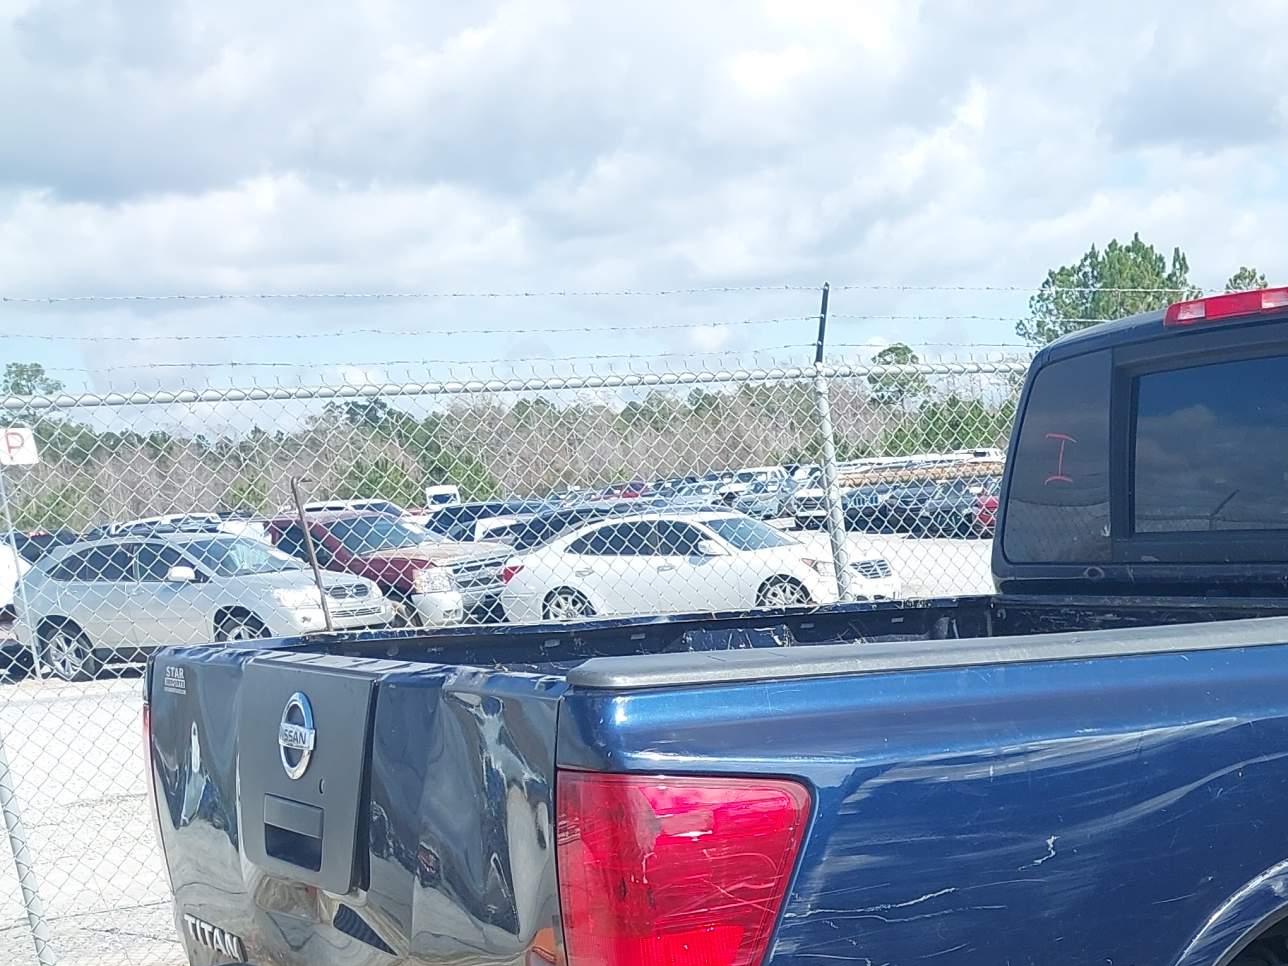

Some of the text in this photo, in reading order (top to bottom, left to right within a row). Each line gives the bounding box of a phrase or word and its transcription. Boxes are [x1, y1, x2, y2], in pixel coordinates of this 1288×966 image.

[4, 432, 25, 455] P
[165, 666, 185, 679] STAR
[183, 914, 243, 963] TITAN
